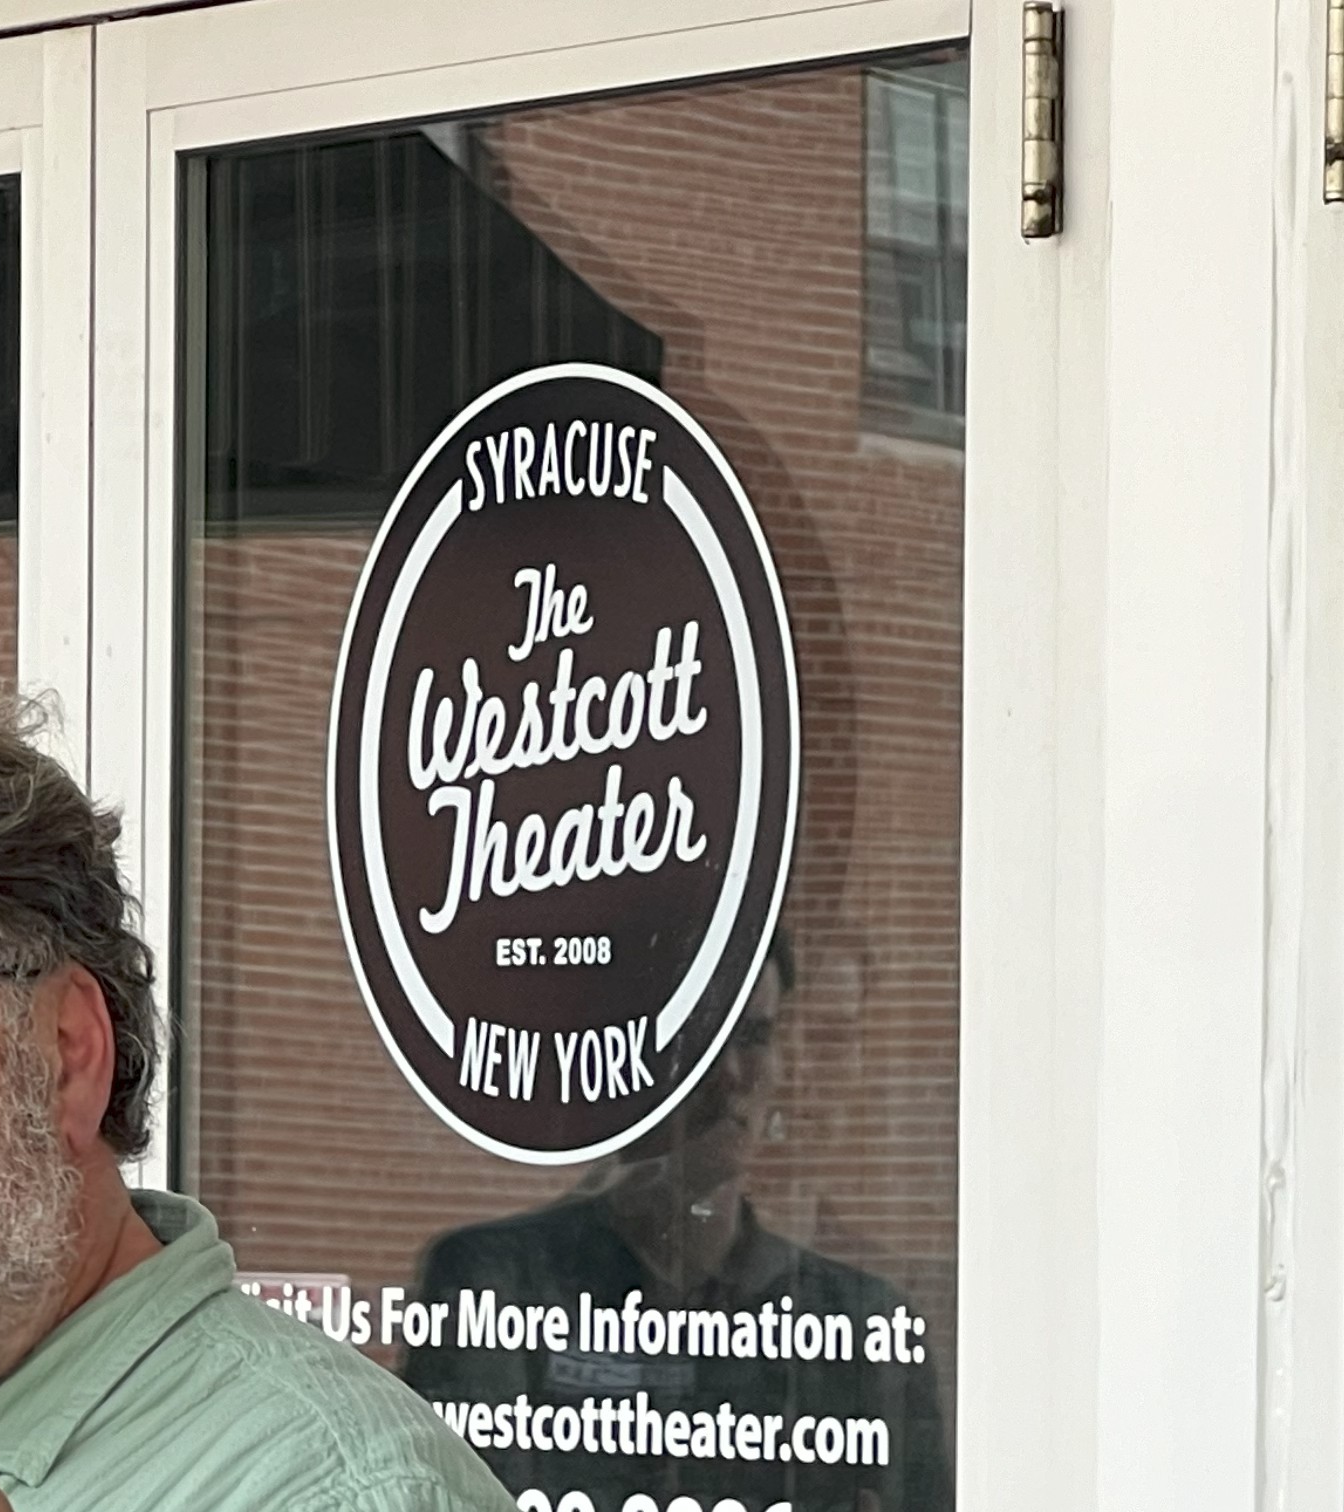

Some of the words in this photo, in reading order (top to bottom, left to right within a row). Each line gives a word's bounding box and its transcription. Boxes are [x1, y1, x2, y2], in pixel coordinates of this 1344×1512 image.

[464, 420, 657, 512] SYRACUSE
[508, 563, 594, 662] The
[407, 620, 708, 789] Westcott
[420, 764, 707, 934] Theater
[496, 937, 546, 966] EST.
[554, 936, 611, 965] 2008
[459, 1017, 541, 1101] NEW
[554, 1015, 655, 1104] YORK
[322, 1285, 371, 1345] Us
[381, 1286, 449, 1347] For
[457, 1289, 569, 1352] More
[579, 1290, 853, 1361] Information
[864, 1305, 926, 1364] at:
